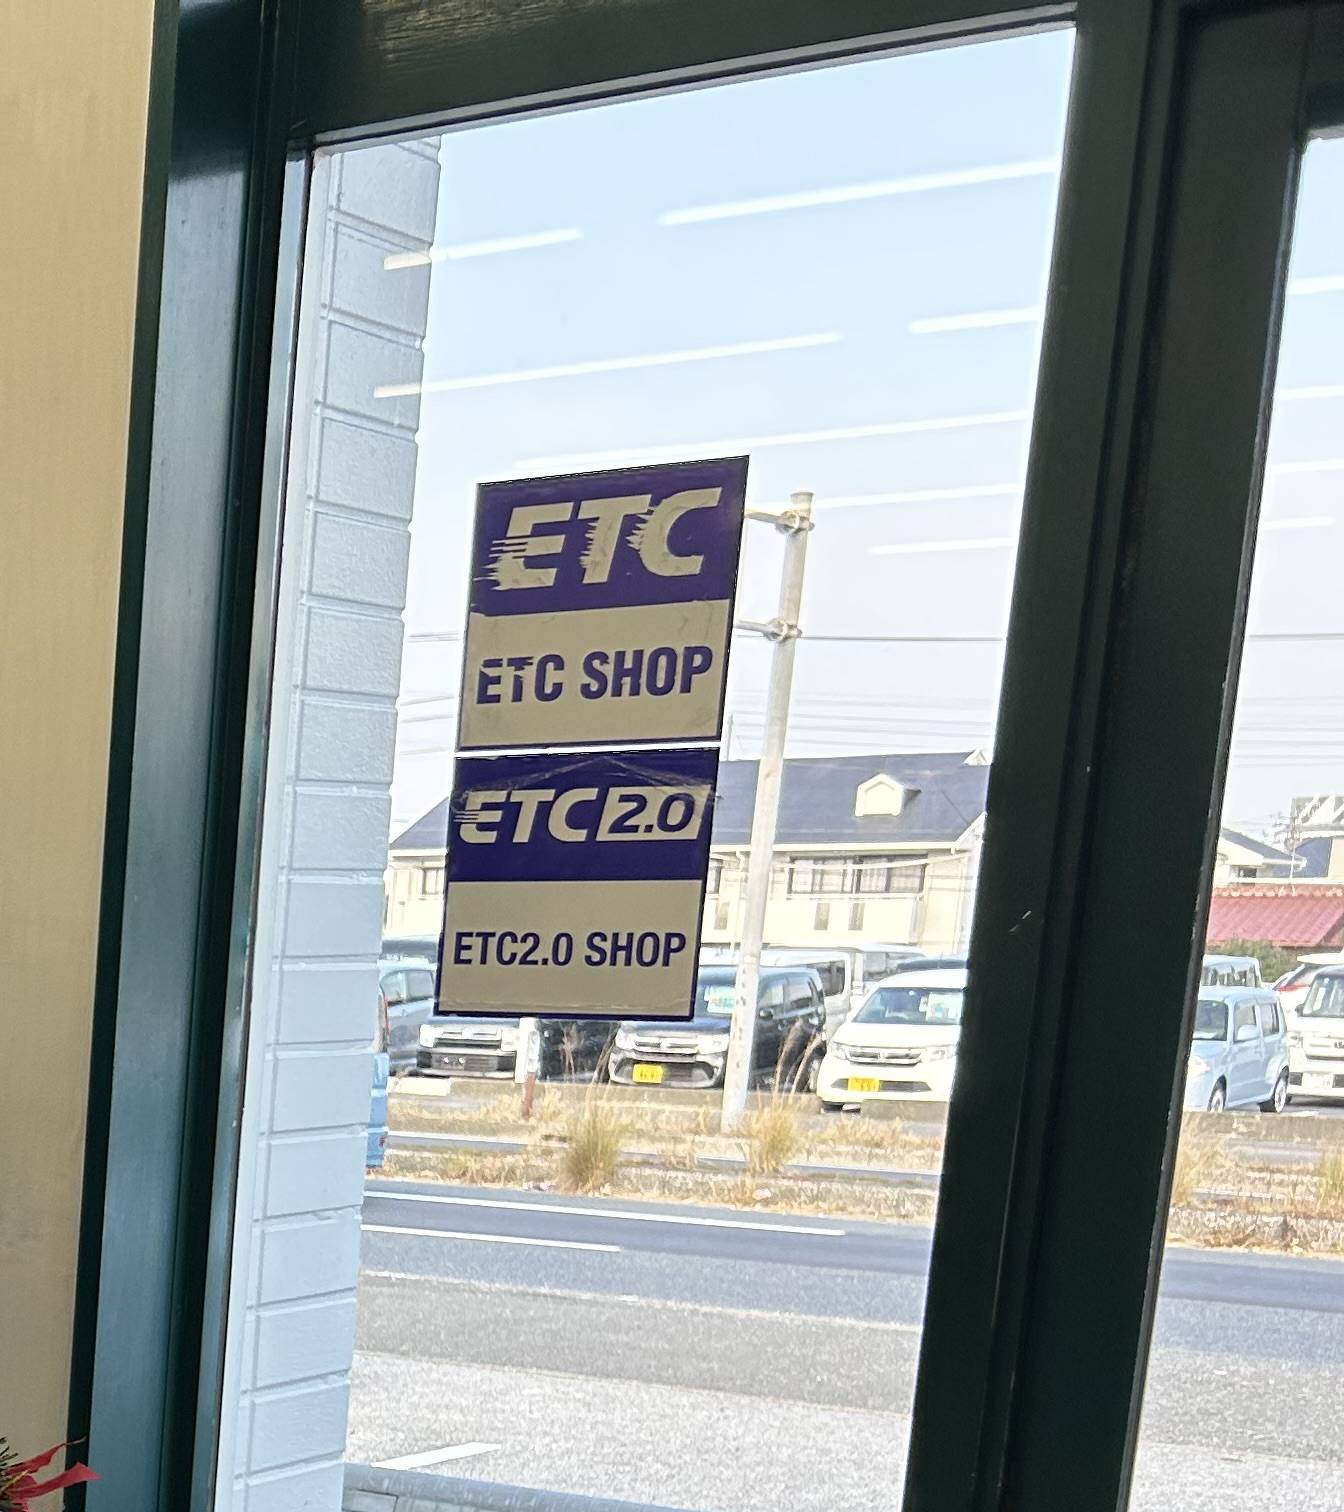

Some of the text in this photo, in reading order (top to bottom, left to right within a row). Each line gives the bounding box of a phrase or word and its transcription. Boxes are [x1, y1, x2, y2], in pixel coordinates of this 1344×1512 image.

[475, 487, 722, 591] ETC
[476, 645, 713, 705] ETC SHOP
[454, 786, 700, 844] ETC2.0
[454, 931, 687, 967] ETC2.0 SHOP
